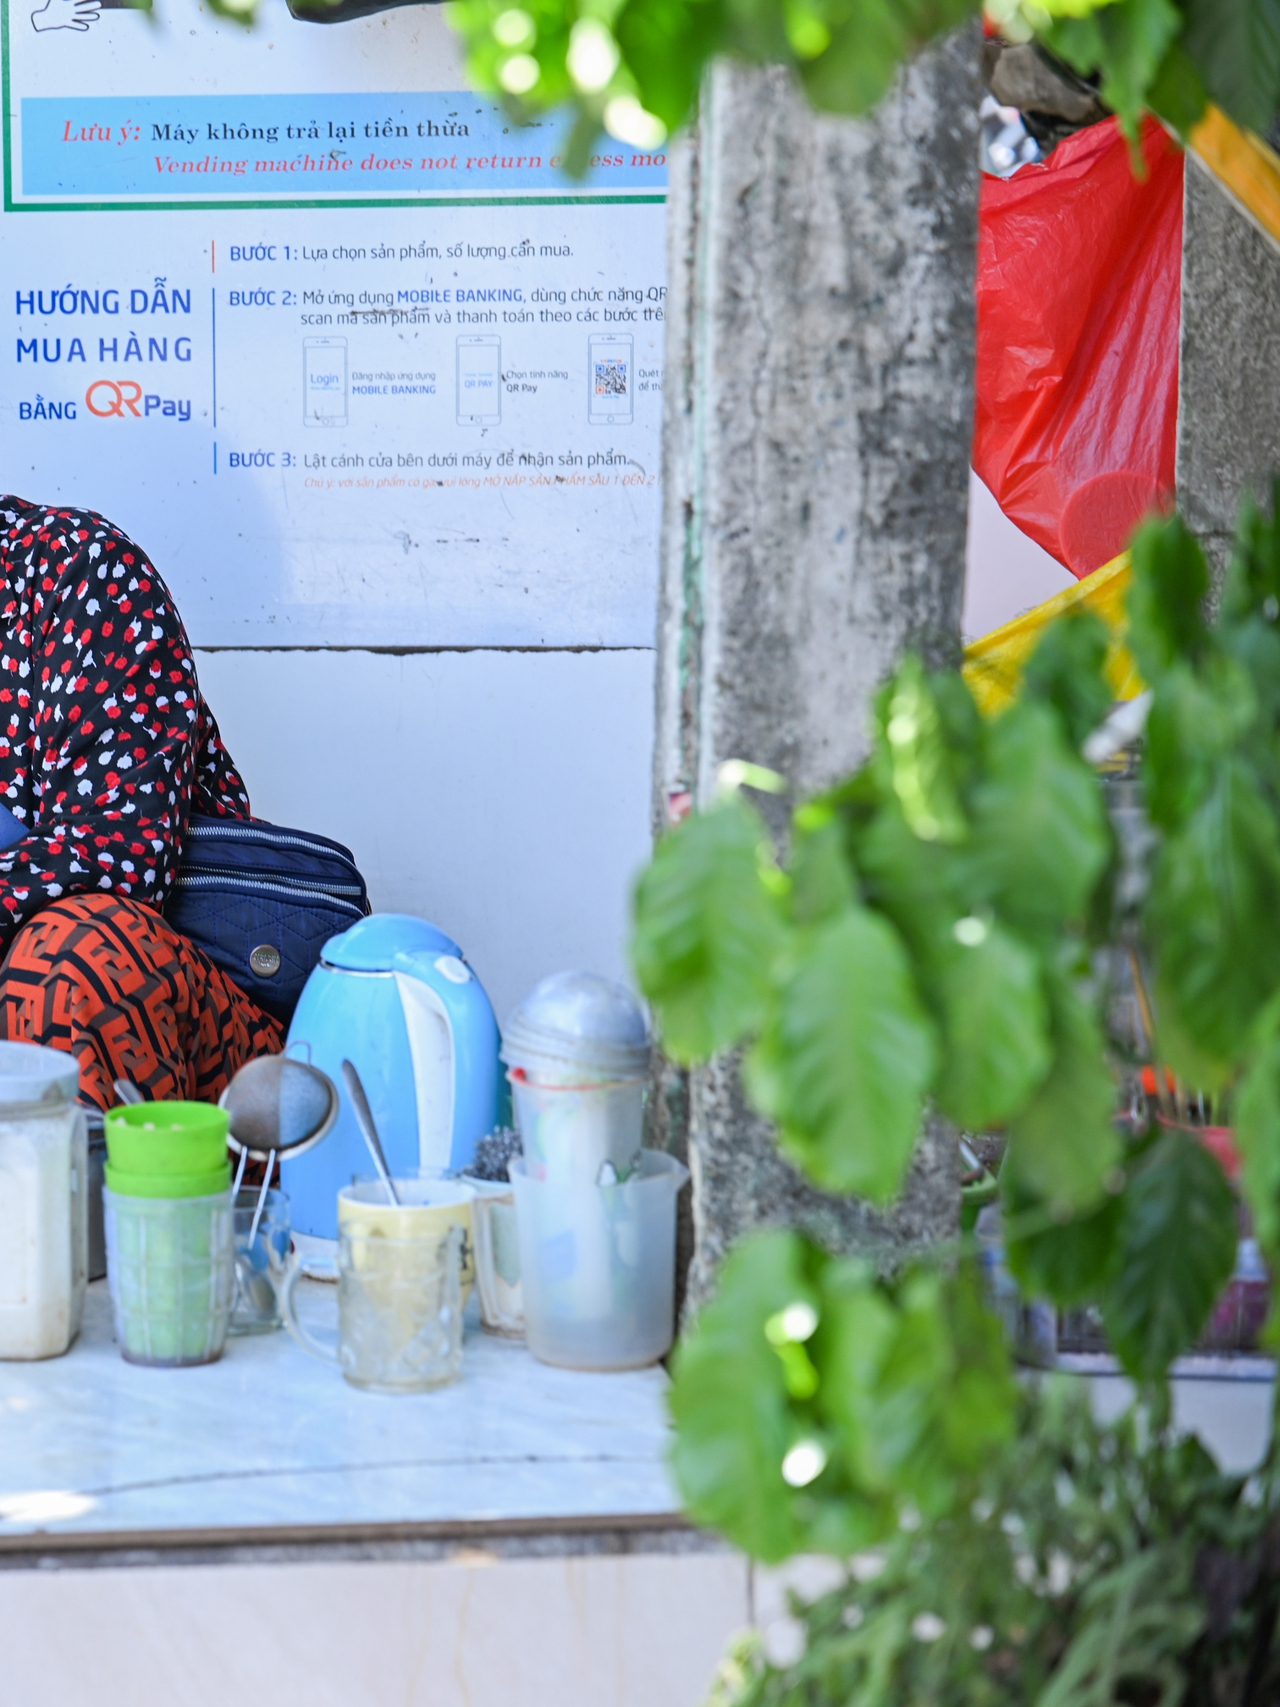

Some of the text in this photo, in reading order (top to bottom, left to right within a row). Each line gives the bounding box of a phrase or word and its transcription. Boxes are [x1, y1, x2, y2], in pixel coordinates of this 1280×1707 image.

[61, 117, 470, 146] Lưu ý: Máy không trả lại tiền thừa
[154, 152, 668, 176] Vending machine does not return eess mo
[229, 242, 277, 261] BƯỚC
[283, 245, 298, 261] 1:
[302, 246, 328, 262] Lựa
[332, 245, 366, 262] chọn
[371, 243, 395, 259] sản
[399, 240, 442, 262] phẩm,
[446, 242, 463, 258] số
[467, 244, 506, 260] lượng
[539, 245, 574, 257] mua.
[16, 277, 191, 315] HƯỚNG DẪN
[229, 286, 668, 307] BƯỚC 2: Mở ứng dụng MOBILE BANKING, dùng chức năng QR
[301, 313, 333, 326] scan
[435, 310, 451, 324] và
[456, 309, 498, 323] thanh
[502, 309, 535, 323] toán
[540, 307, 572, 322] theo
[576, 307, 599, 322] các
[604, 307, 638, 322] bước
[643, 307, 668, 322] trê
[16, 331, 191, 362] MUA HÀNG
[310, 373, 339, 386] Login
[352, 371, 373, 382] Đăng
[375, 371, 395, 382] nhập
[352, 385, 389, 395] MOBILE
[391, 385, 436, 395] BANKING
[506, 383, 538, 394] QR Pay
[19, 394, 77, 420] BẰNG
[229, 448, 630, 470] BƯỚC 3: Lật cánh cửa bên dưới máy để nhận sản phẩm.
